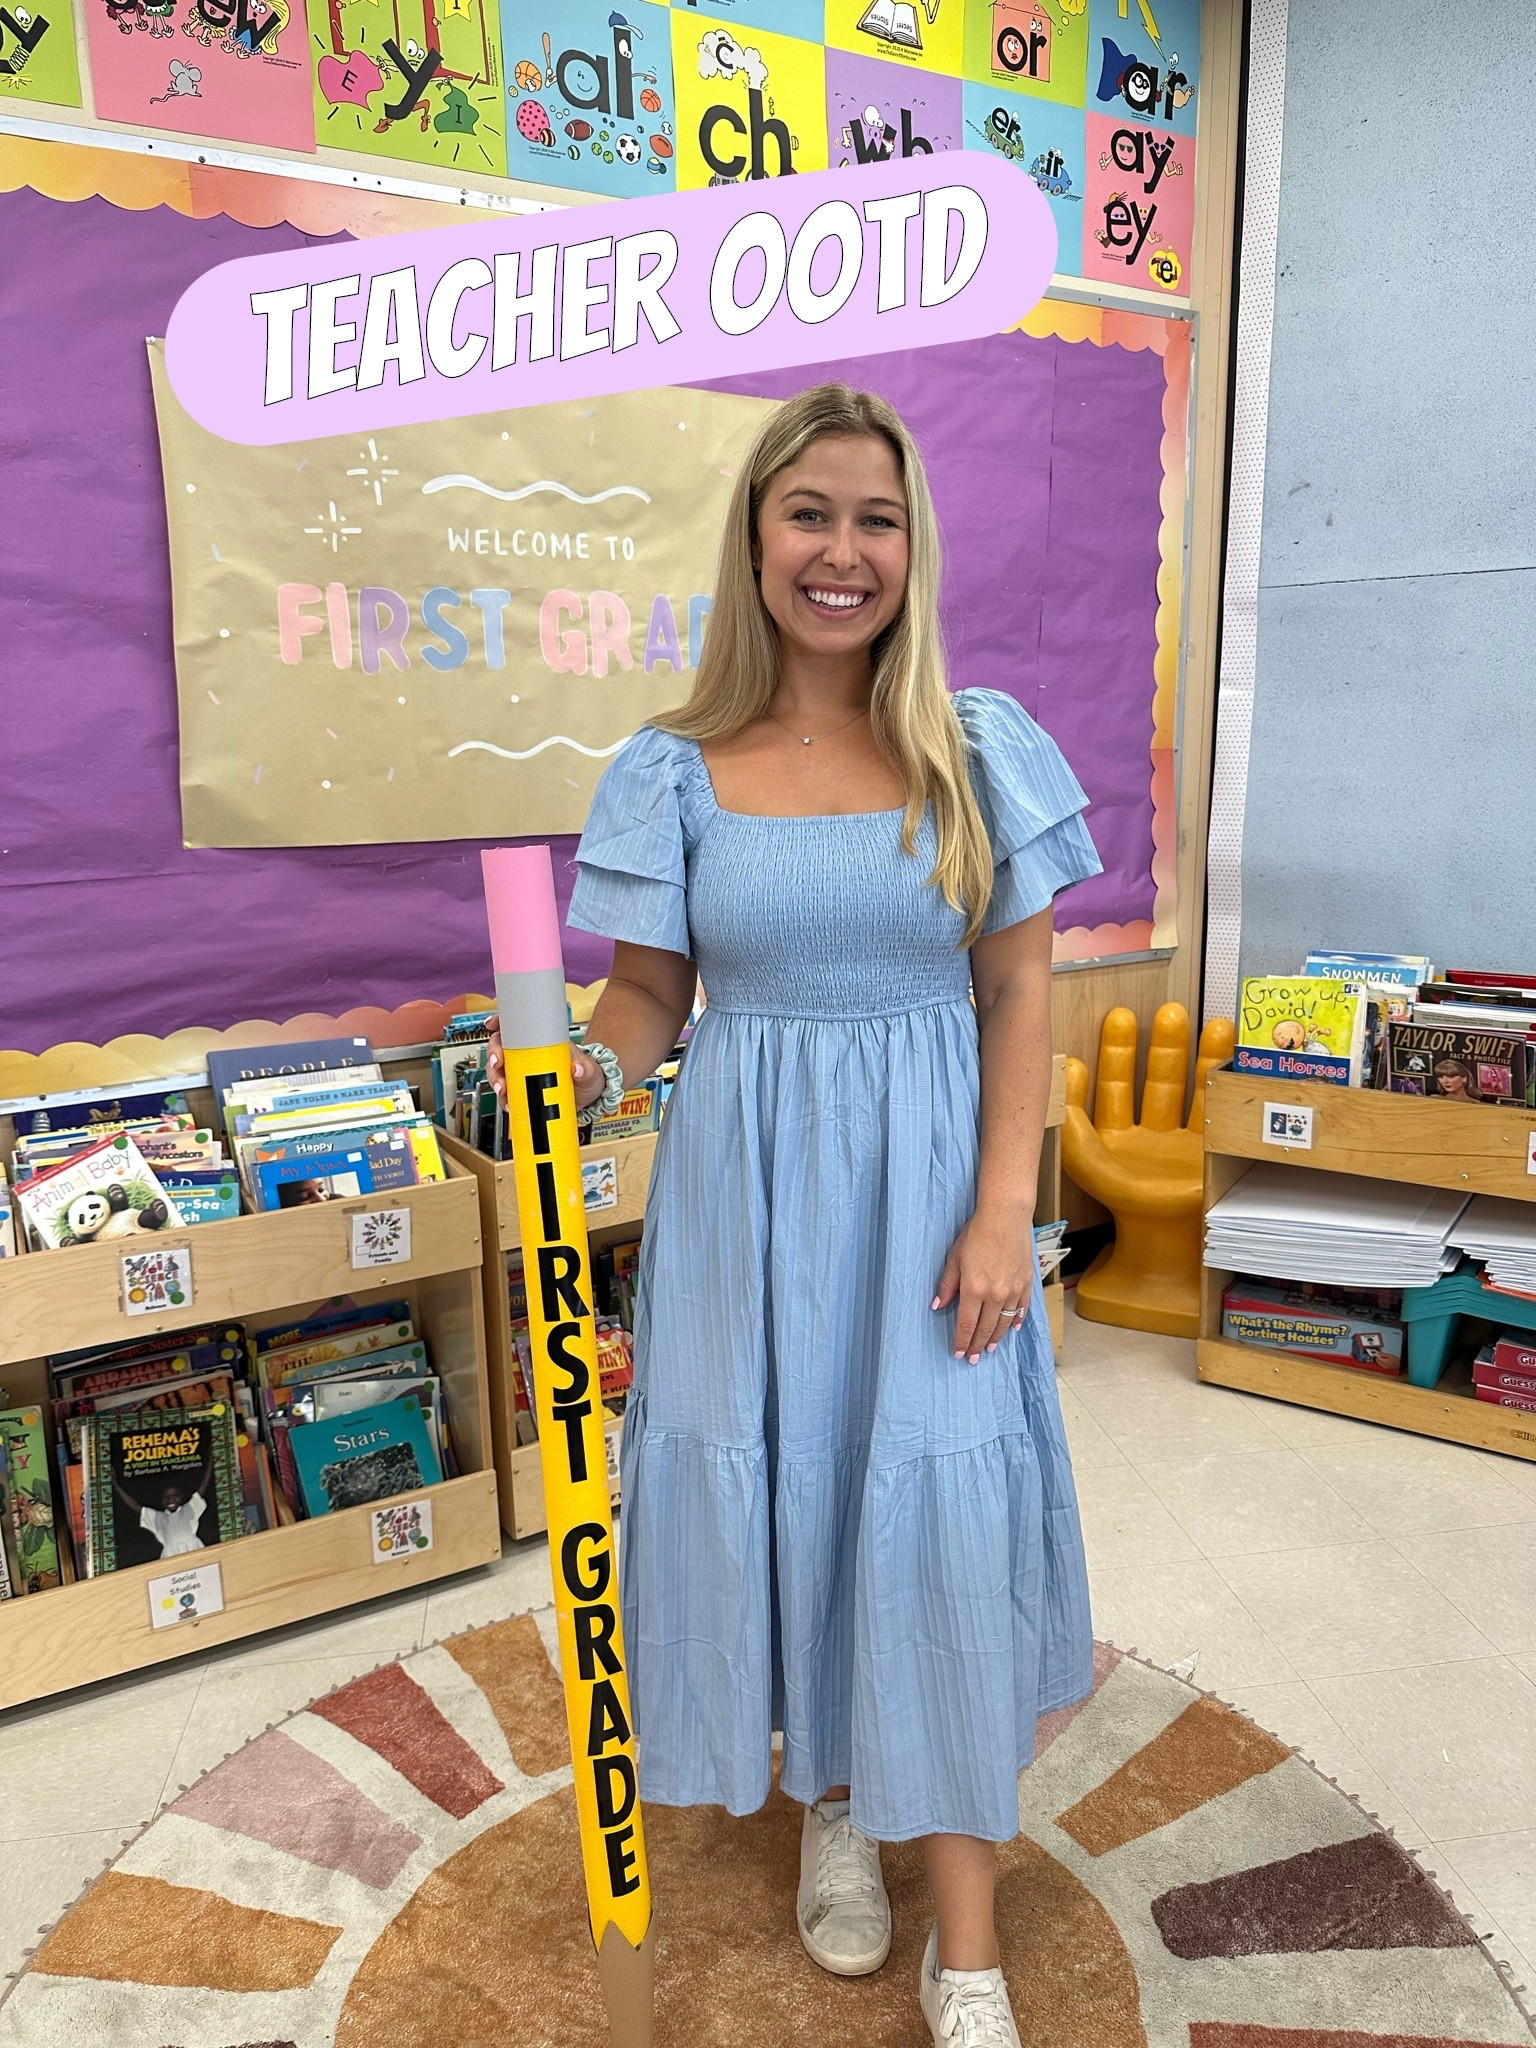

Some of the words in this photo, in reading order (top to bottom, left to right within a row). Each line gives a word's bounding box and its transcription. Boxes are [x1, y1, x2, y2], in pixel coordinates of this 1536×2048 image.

[997, 26, 1048, 77] or
[382, 38, 444, 120] y
[556, 26, 635, 120] al
[1124, 62, 1188, 121] ar
[699, 88, 792, 180] ch
[991, 107, 1021, 140] er
[1045, 150, 1065, 178] ir
[1111, 128, 1176, 194] ay
[1104, 200, 1158, 265] ey
[447, 527, 590, 561] WELCOME
[603, 534, 636, 562] TO
[276, 582, 513, 676] FIRST
[1321, 966, 1402, 984] SNOWMEN
[1245, 979, 1312, 1005] Grow
[1242, 998, 1317, 1032] David!
[1393, 1026, 1457, 1052] TAYLOR
[1462, 1034, 1520, 1059] SWIFT
[1238, 1051, 1273, 1071] Sea
[1279, 1056, 1348, 1079] Horses
[1450, 1052, 1465, 1060] FACT
[1474, 1055, 1496, 1064] PHOTO
[341, 1090, 366, 1099] MARK
[620, 1094, 651, 1116] WIN?
[89, 1126, 103, 1135] The
[611, 1126, 633, 1135] SHARK
[152, 1150, 205, 1161] Ancestors
[296, 1142, 335, 1154] Happy
[383, 1157, 402, 1167] Day
[31, 1169, 91, 1213] Animal
[86, 1149, 131, 1180] Baby
[174, 1198, 220, 1211] p-Sea
[128, 1270, 179, 1287] SCIENCE
[524, 1072, 593, 1484] FIRST
[1229, 1314, 1272, 1327] What's
[1272, 1319, 1293, 1331] the
[1295, 1321, 1348, 1337] Rhyme?
[1238, 1326, 1285, 1343] Sorting
[1287, 1331, 1335, 1346] Houses
[268, 1328, 302, 1349] MORE
[84, 1360, 169, 1388] ABRAHAM
[281, 1356, 313, 1371] THE
[122, 1426, 201, 1450] REHEMA'S
[333, 1427, 391, 1452] Stars
[123, 1441, 200, 1463] JOURNEY
[123, 1470, 133, 1478] by
[134, 1467, 162, 1476] Barbara
[169, 1582, 202, 1596] Studies
[171, 1571, 198, 1585] Social
[561, 1522, 641, 1898] GRADE
